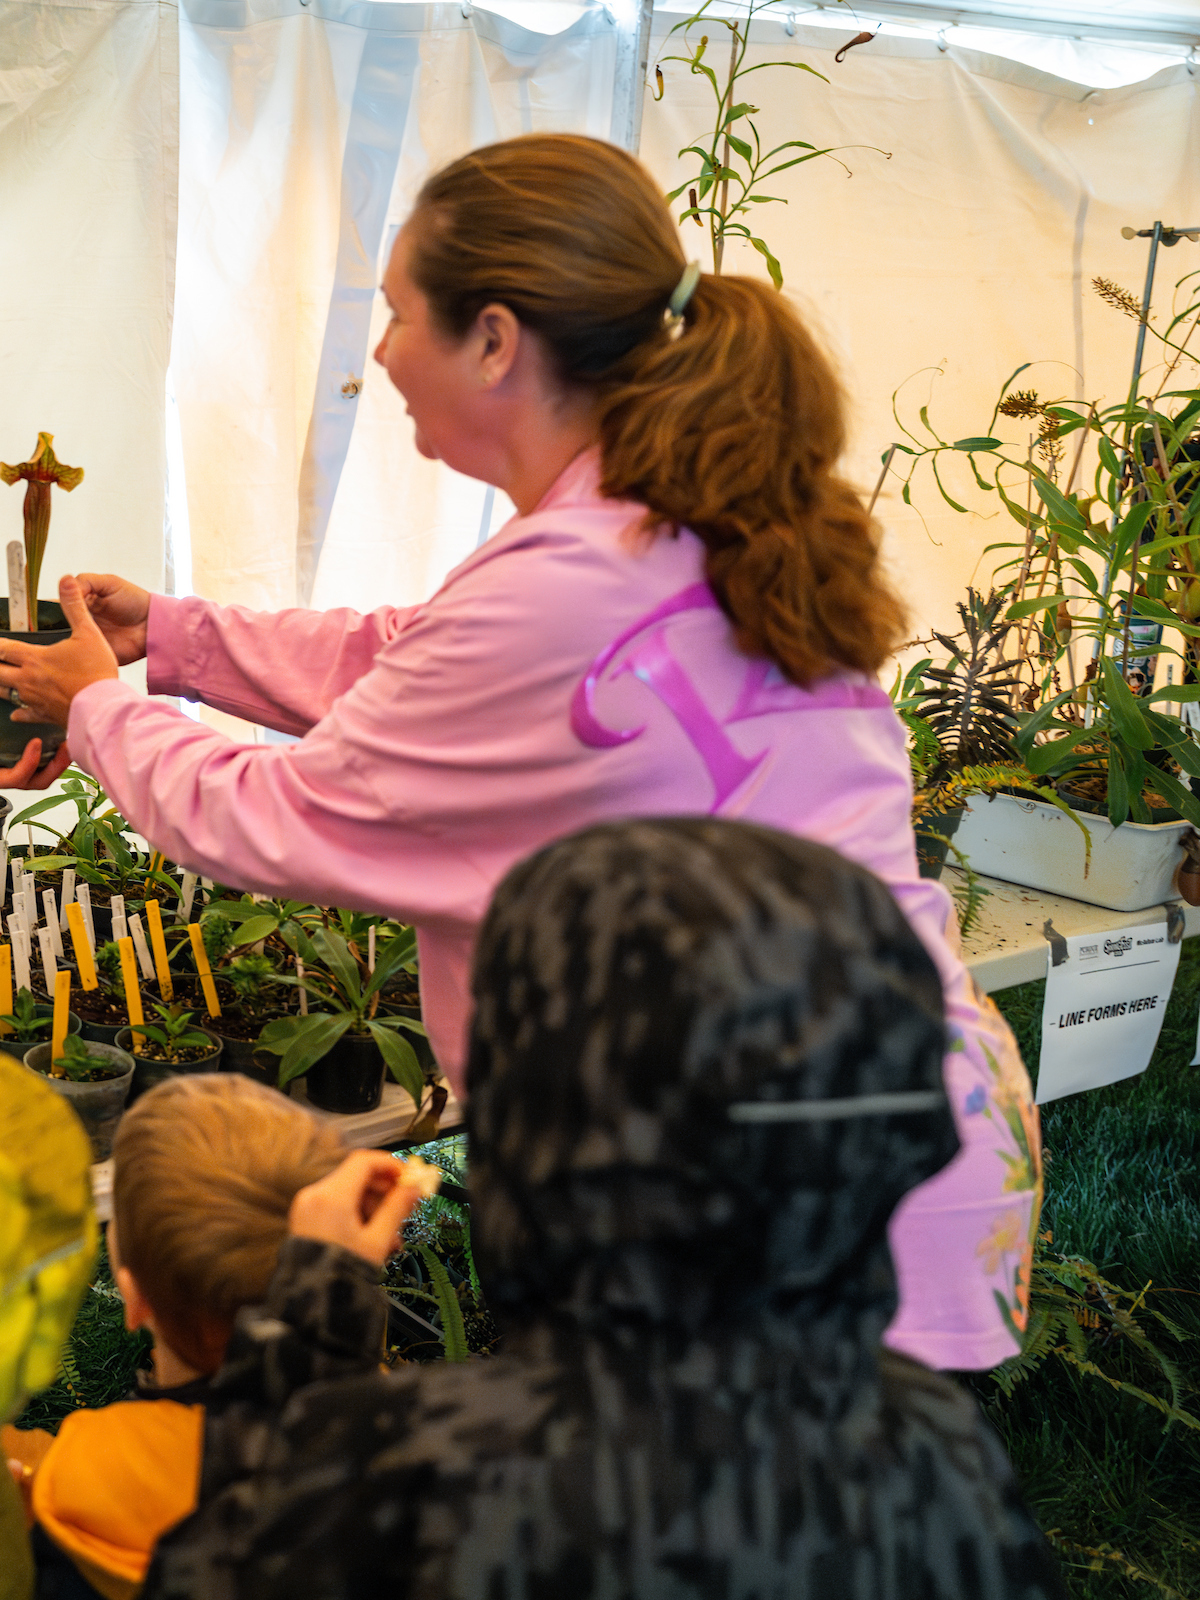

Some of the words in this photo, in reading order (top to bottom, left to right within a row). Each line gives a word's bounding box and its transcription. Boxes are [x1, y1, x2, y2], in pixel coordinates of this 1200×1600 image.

[1058, 1010, 1086, 1029] LINE
[1087, 1002, 1127, 1022] FORMS
[1129, 995, 1158, 1014] HERE
